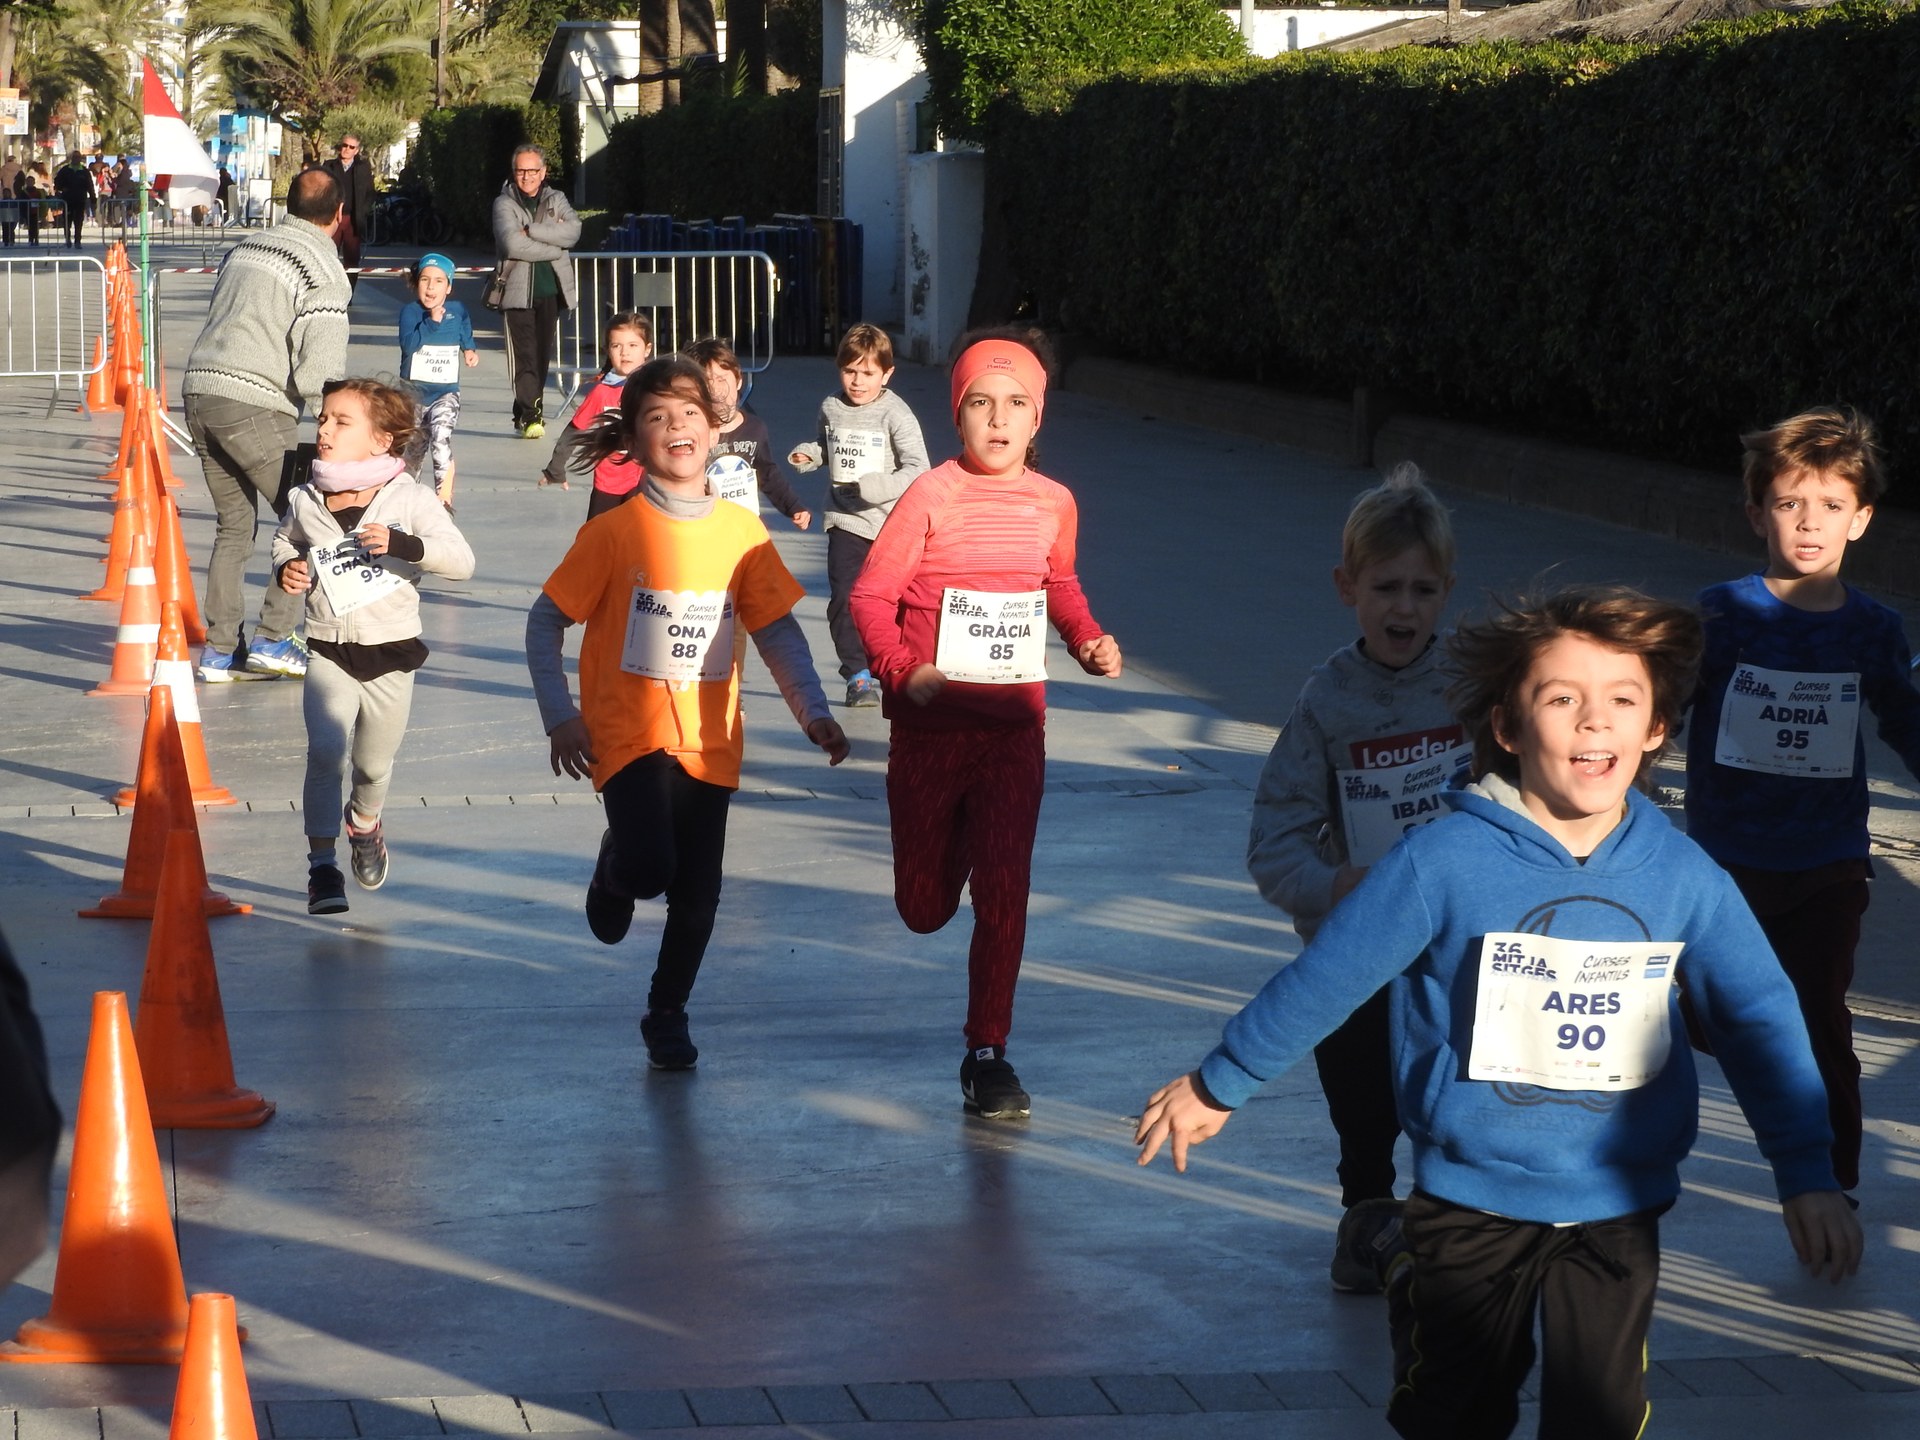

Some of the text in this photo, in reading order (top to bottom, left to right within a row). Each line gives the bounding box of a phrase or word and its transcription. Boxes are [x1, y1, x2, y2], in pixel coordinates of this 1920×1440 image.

[834, 446, 865, 457] ANIOL
[840, 458, 856, 469] 98
[721, 488, 748, 499] RCEL
[360, 563, 383, 583] 99
[687, 604, 717, 612] CURSES
[1003, 601, 1029, 610] CURSES
[681, 613, 717, 621] INFANTILS
[998, 610, 1029, 619] INFANTILS
[667, 624, 707, 639] ONA
[968, 622, 1031, 639] GRÀCIA
[671, 642, 698, 659] 88
[989, 643, 1014, 660] 85
[1794, 681, 1830, 691] CURSES
[1788, 693, 1832, 702] INFANTILS
[1759, 705, 1828, 725] ADRIÀ
[1776, 728, 1809, 750] 95
[1362, 736, 1456, 768] Louder
[1404, 764, 1441, 783] CURSES
[1402, 774, 1446, 795] INFANTILS
[1391, 794, 1440, 820] IBAI
[1583, 955, 1632, 968] CURSES
[1574, 969, 1631, 983] INFANTILS
[1541, 991, 1621, 1015] ARES
[1556, 1023, 1606, 1051] 90
